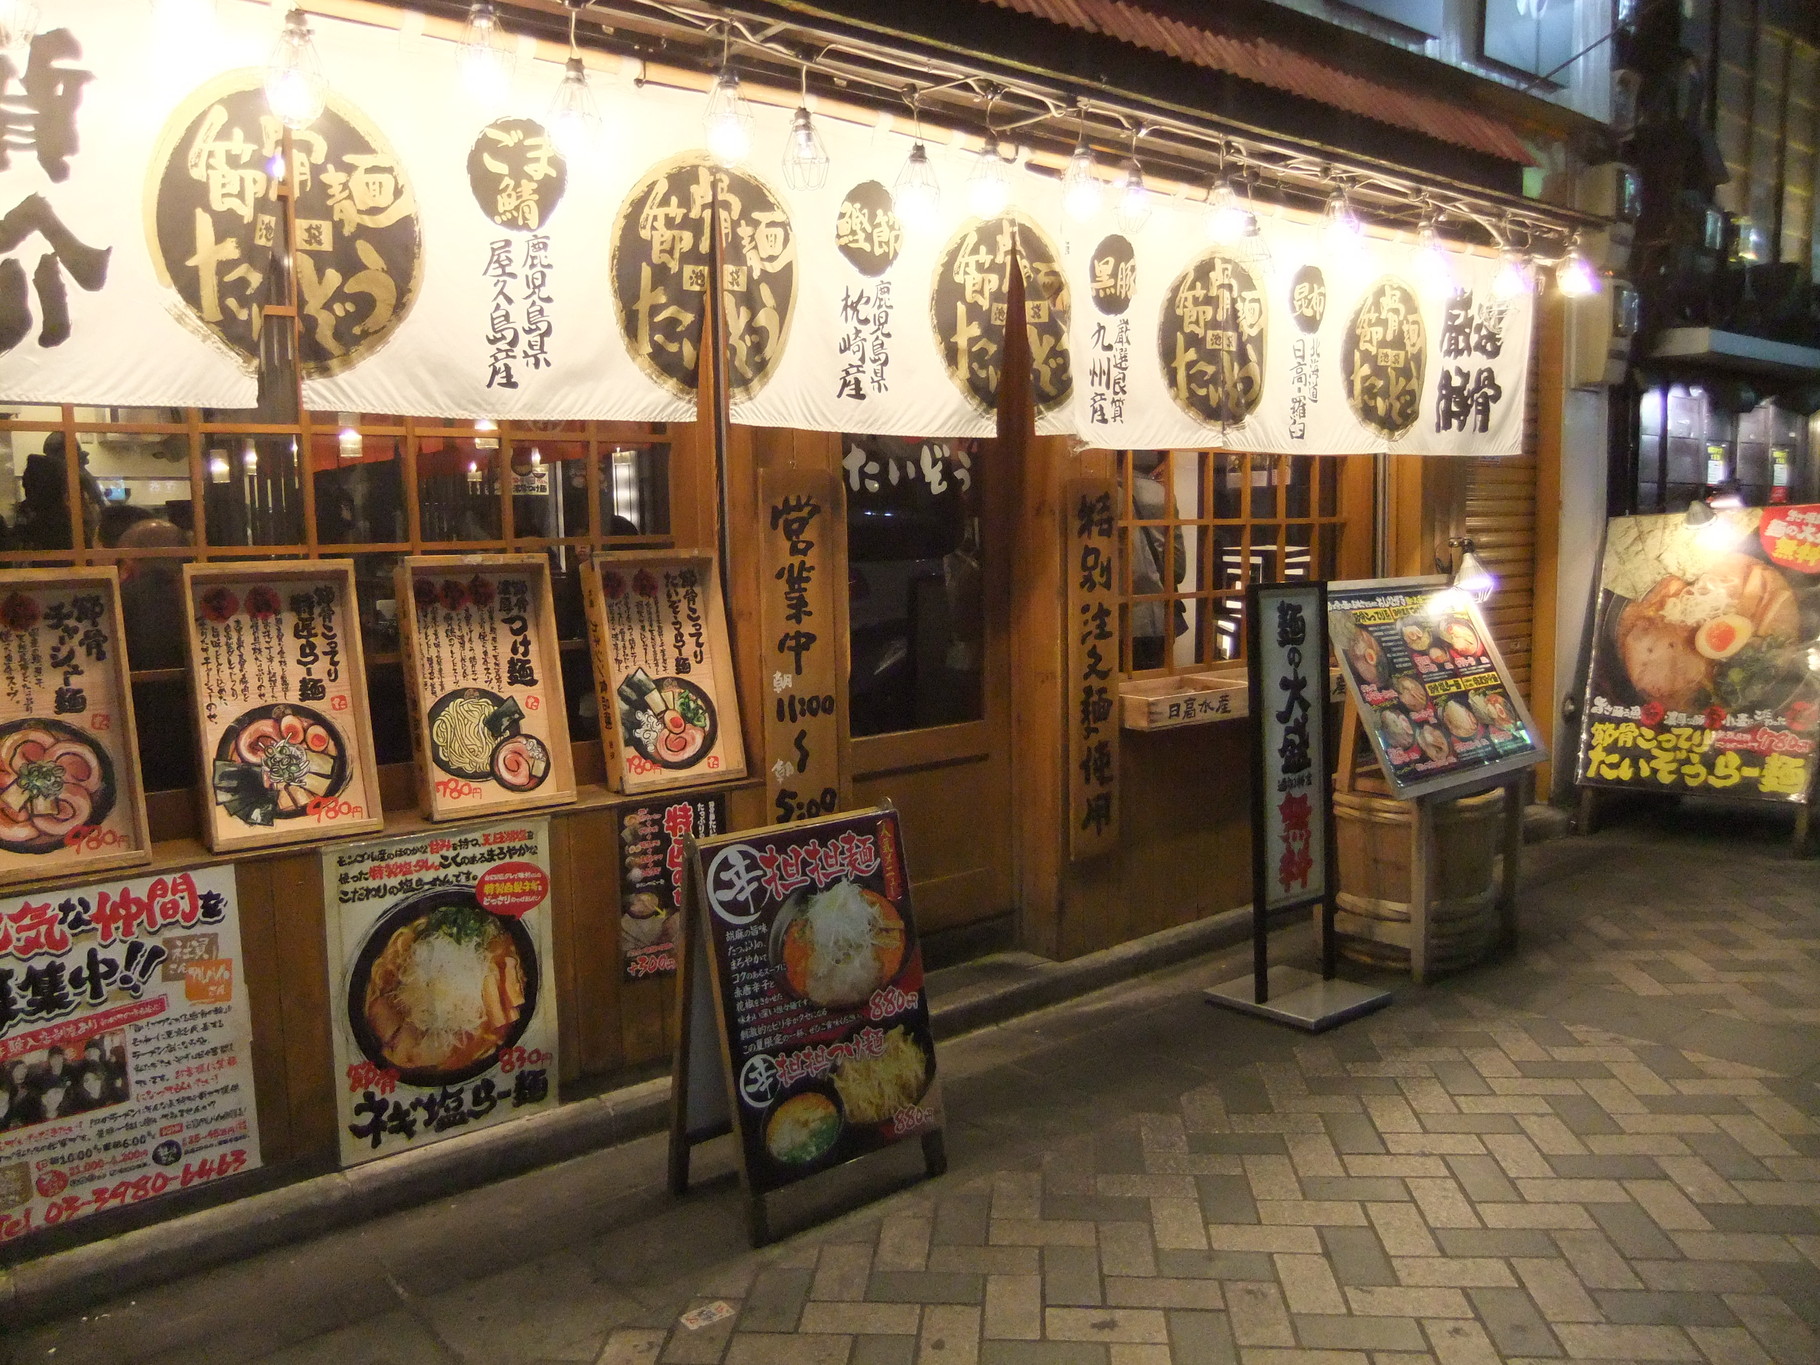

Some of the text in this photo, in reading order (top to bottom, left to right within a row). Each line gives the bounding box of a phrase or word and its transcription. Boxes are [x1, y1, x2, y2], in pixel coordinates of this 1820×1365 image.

[483, 128, 558, 180] ごま
[494, 176, 539, 229] 鯖
[836, 201, 901, 260] 鰹節
[521, 234, 554, 370] 鹿児島県
[1090, 256, 1137, 299] 黒豚
[1293, 283, 1326, 320] 昆布
[482, 239, 520, 389] 屋久島産
[836, 285, 872, 400] 枕崎産
[869, 280, 893, 394] 鹿児島県
[1090, 322, 1114, 424] 九州産
[1111, 318, 1131, 424] 厳選良質
[1308, 337, 1321, 403] 北海道
[842, 443, 971, 495] たいぞう
[770, 495, 821, 676] 営業中
[502, 615, 538, 687] つけ麺
[776, 695, 835, 722] 11:00
[1276, 600, 1312, 775] 麺の大盛
[1590, 721, 1713, 753] 節骨こってり
[435, 778, 482, 800] 780円
[1586, 745, 1806, 795] たいぞうらー麺
[306, 796, 364, 823] 980円
[775, 787, 837, 824] 5:00
[759, 830, 881, 900] 担担麺
[880, 822, 897, 896] 人気メニュー
[869, 987, 919, 1020] 880円
